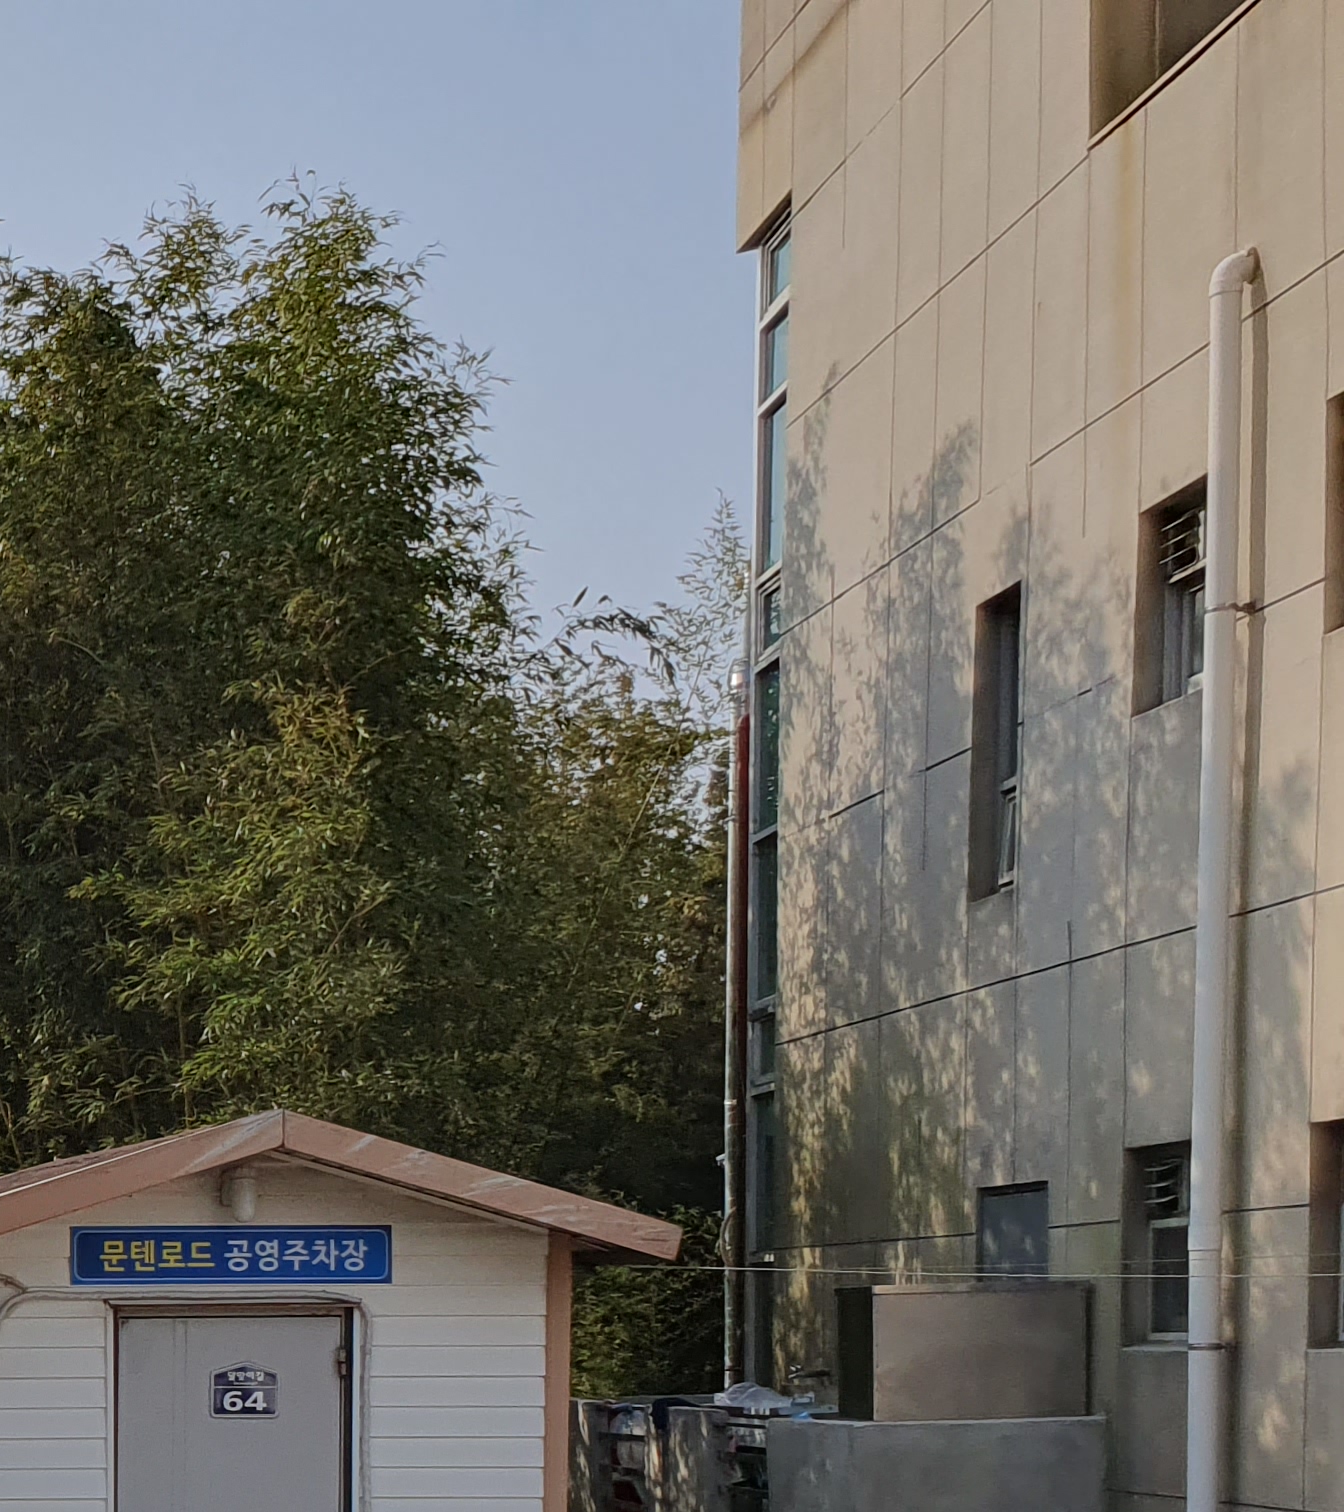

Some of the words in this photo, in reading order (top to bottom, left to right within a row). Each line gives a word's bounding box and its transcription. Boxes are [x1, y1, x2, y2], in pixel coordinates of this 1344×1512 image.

[99, 1239, 215, 1272] 문텐로드
[223, 1238, 368, 1272] 공영주차장
[223, 1390, 267, 1411] 64
